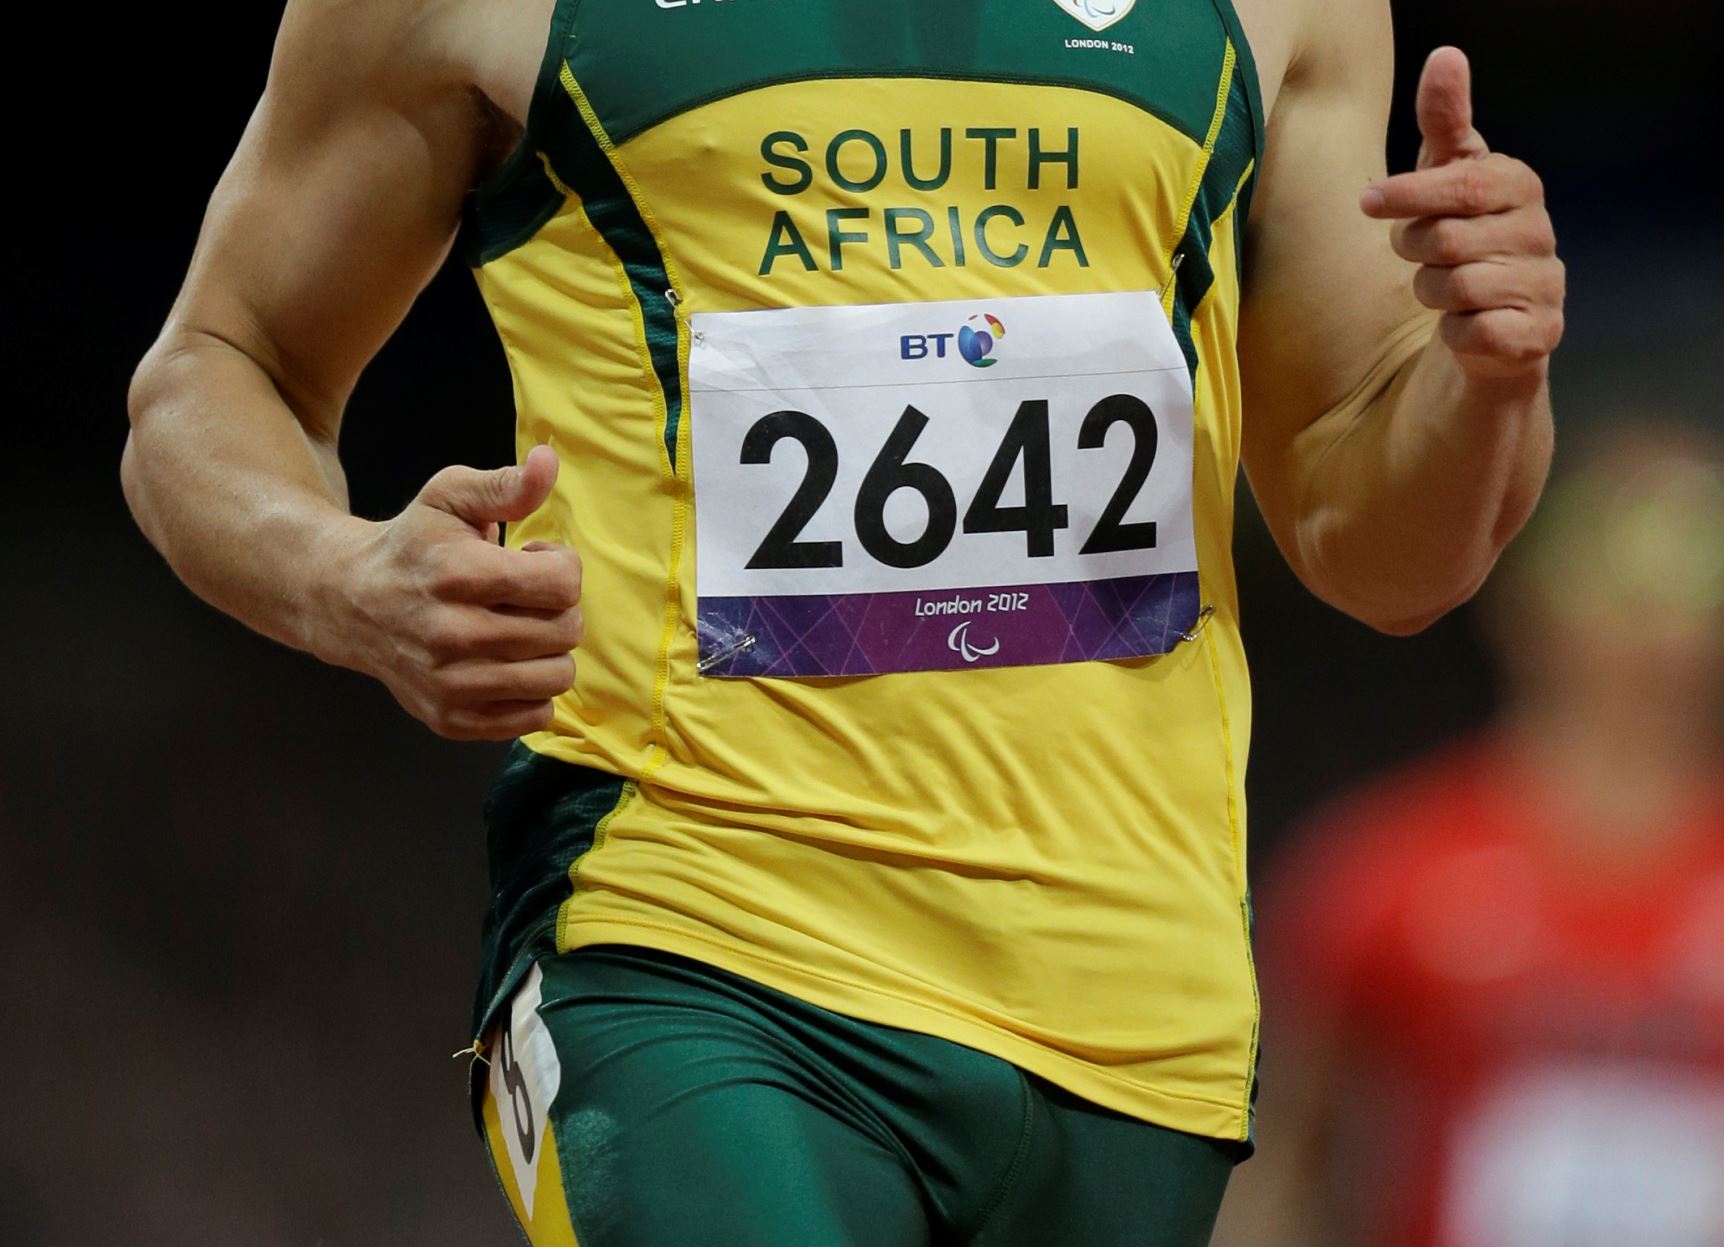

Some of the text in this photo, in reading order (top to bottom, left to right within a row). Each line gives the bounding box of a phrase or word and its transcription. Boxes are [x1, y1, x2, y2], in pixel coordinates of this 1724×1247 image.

[1065, 39, 1135, 54] LONDON 2012
[760, 127, 1080, 196] SOUTH
[758, 205, 1090, 277] AFRICA
[900, 332, 955, 361] BT
[739, 393, 1159, 570] 2642
[915, 592, 1029, 617] London 2012
